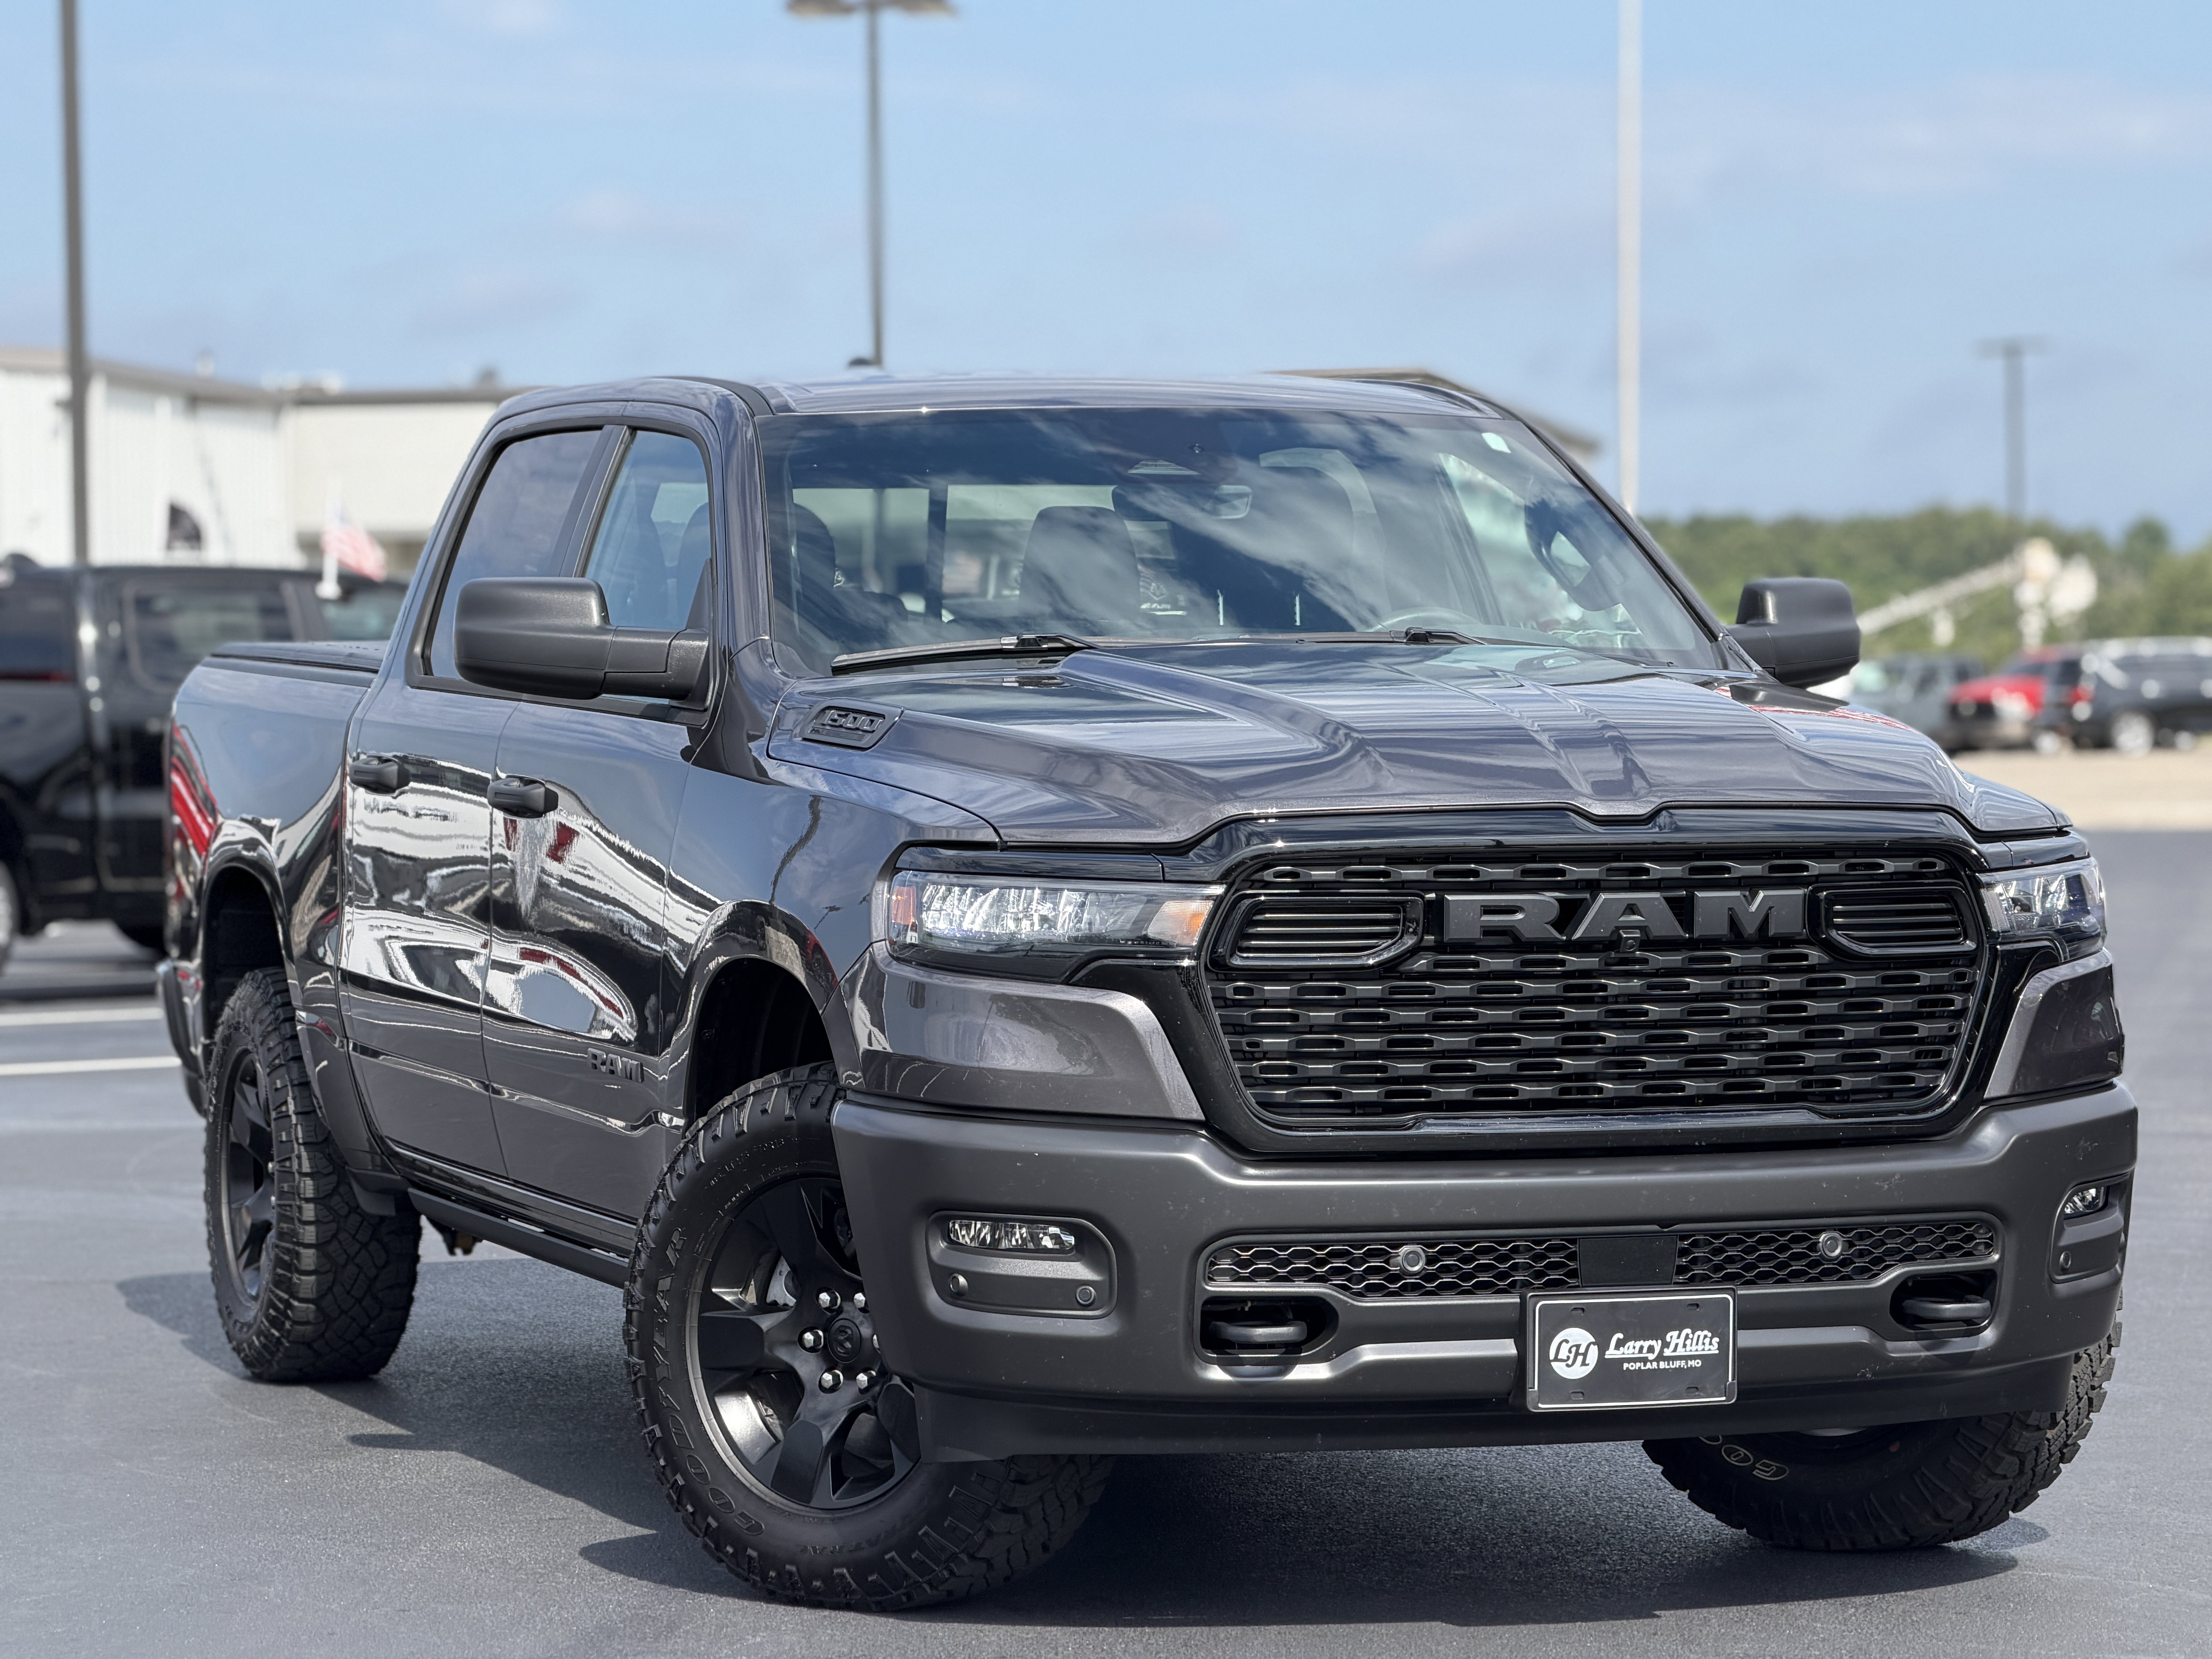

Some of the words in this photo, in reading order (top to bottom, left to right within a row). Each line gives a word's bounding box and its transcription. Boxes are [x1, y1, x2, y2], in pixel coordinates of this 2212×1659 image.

[1444, 890, 1805, 943] RAM
[587, 1048, 644, 1083] RAM
[1604, 1333, 1662, 1360] Larry
[1663, 1328, 1719, 1356] Hillis
[1623, 1362, 1658, 1370] POPLAR
[1659, 1360, 1687, 1369] BLUFF,
[1688, 1359, 1702, 1367] MO
